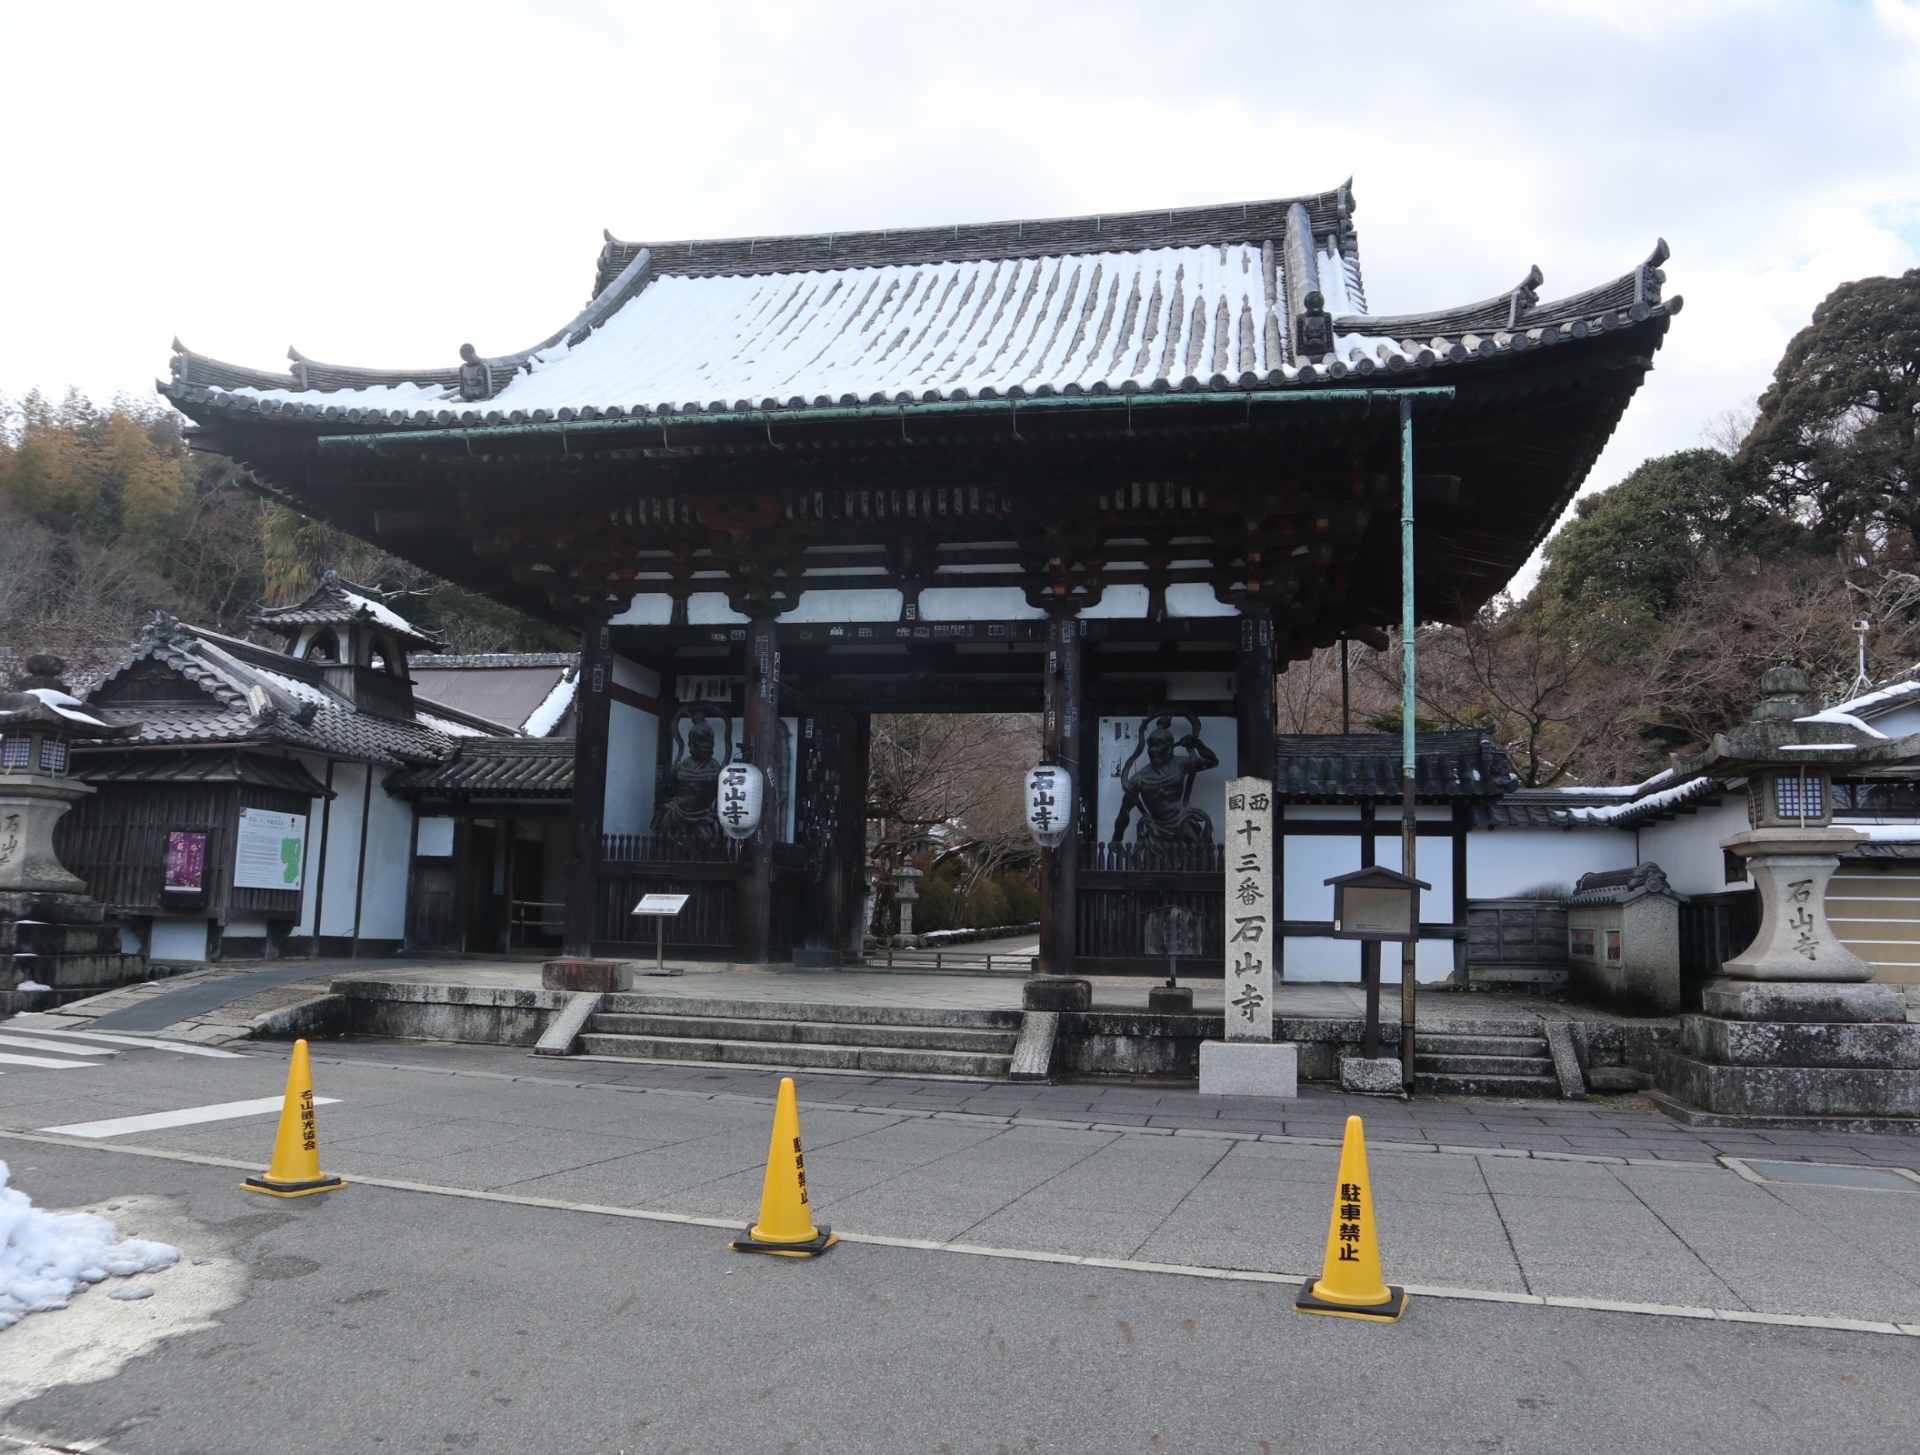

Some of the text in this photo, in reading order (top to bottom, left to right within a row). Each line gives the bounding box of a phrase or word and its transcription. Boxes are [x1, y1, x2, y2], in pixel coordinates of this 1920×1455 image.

[722, 767, 749, 825] 石山寺
[1030, 770, 1059, 831] 石山寺
[1785, 879, 1820, 961] 石山寺
[300, 1089, 316, 1151] 石山観光協会
[1338, 1183, 1361, 1262] 駐車禁止
